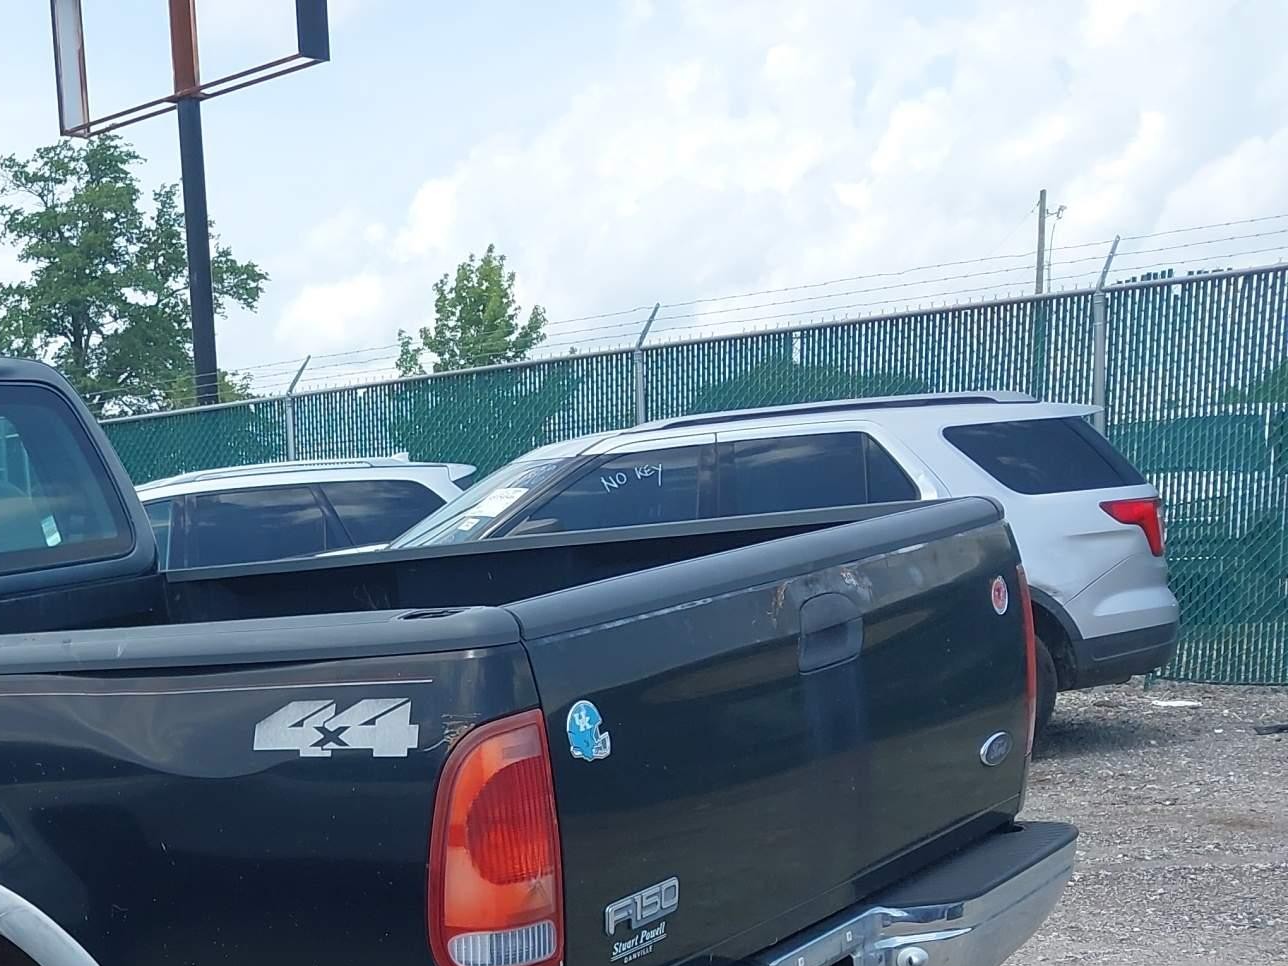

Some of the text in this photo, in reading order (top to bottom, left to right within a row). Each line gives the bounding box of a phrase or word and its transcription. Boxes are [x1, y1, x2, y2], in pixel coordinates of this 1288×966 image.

[601, 463, 662, 492] NO KEY
[612, 921, 666, 956] Stuart Powell
